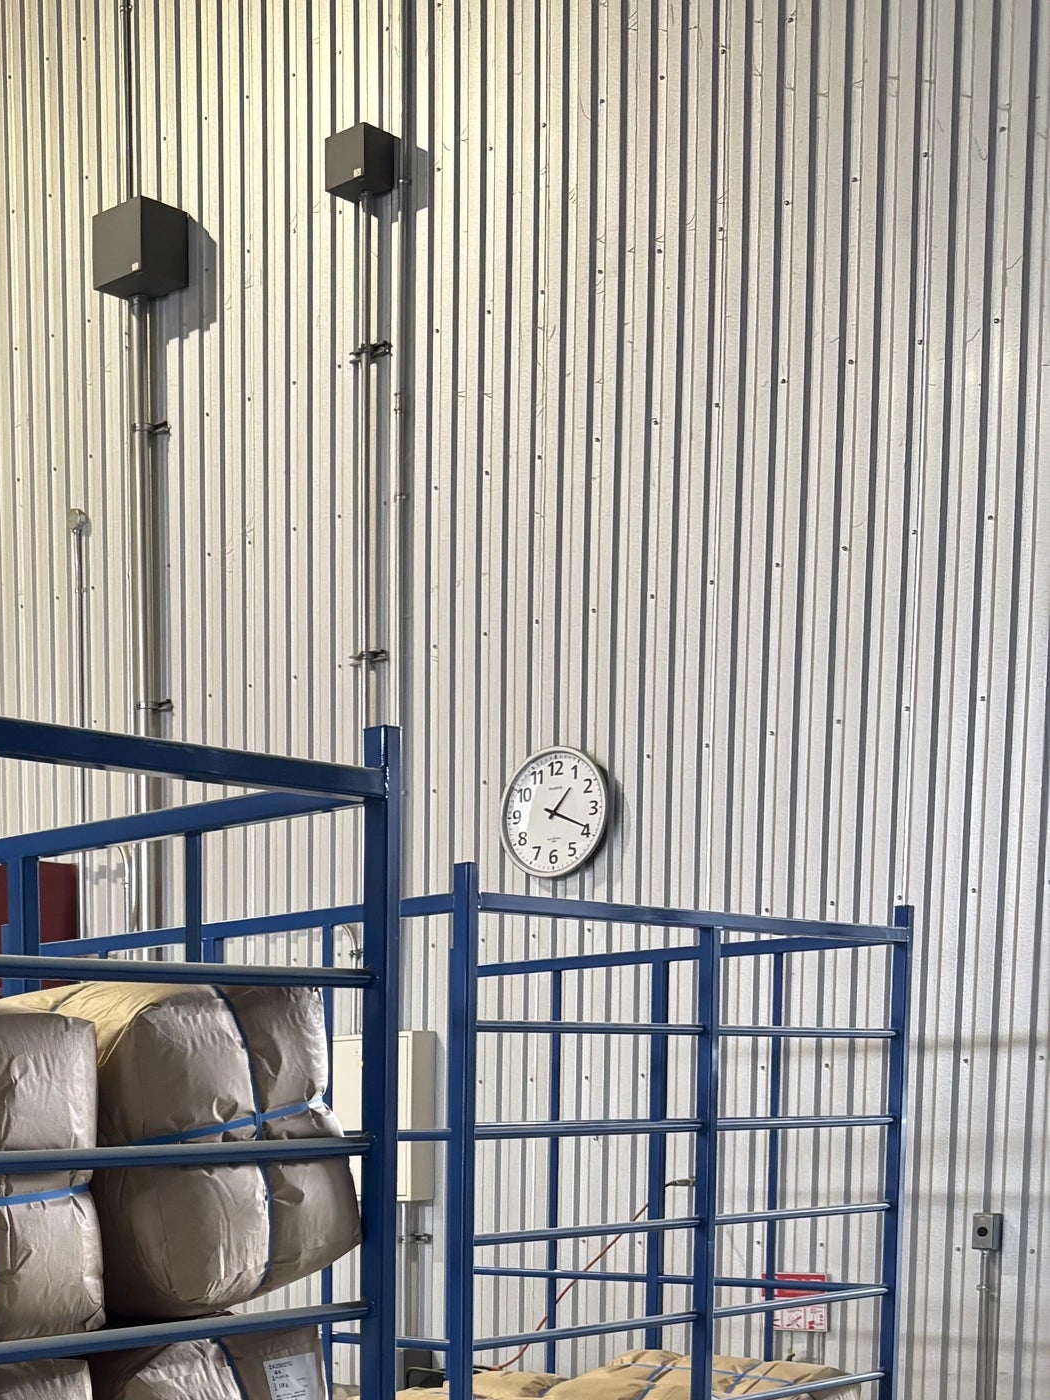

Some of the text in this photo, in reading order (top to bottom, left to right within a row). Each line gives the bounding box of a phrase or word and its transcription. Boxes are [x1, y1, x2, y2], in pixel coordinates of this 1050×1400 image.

[547, 761, 564, 776] 12
[571, 765, 578, 779] 1
[531, 770, 543, 785] 11
[583, 779, 593, 793] 2
[518, 787, 532, 803] 10
[588, 800, 598, 816] 3
[512, 810, 522, 825] 9
[581, 823, 591, 838] 4
[518, 832, 528, 846] 8
[532, 846, 542, 860] 7
[549, 849, 558, 864] 6
[567, 842, 577, 857] 5
